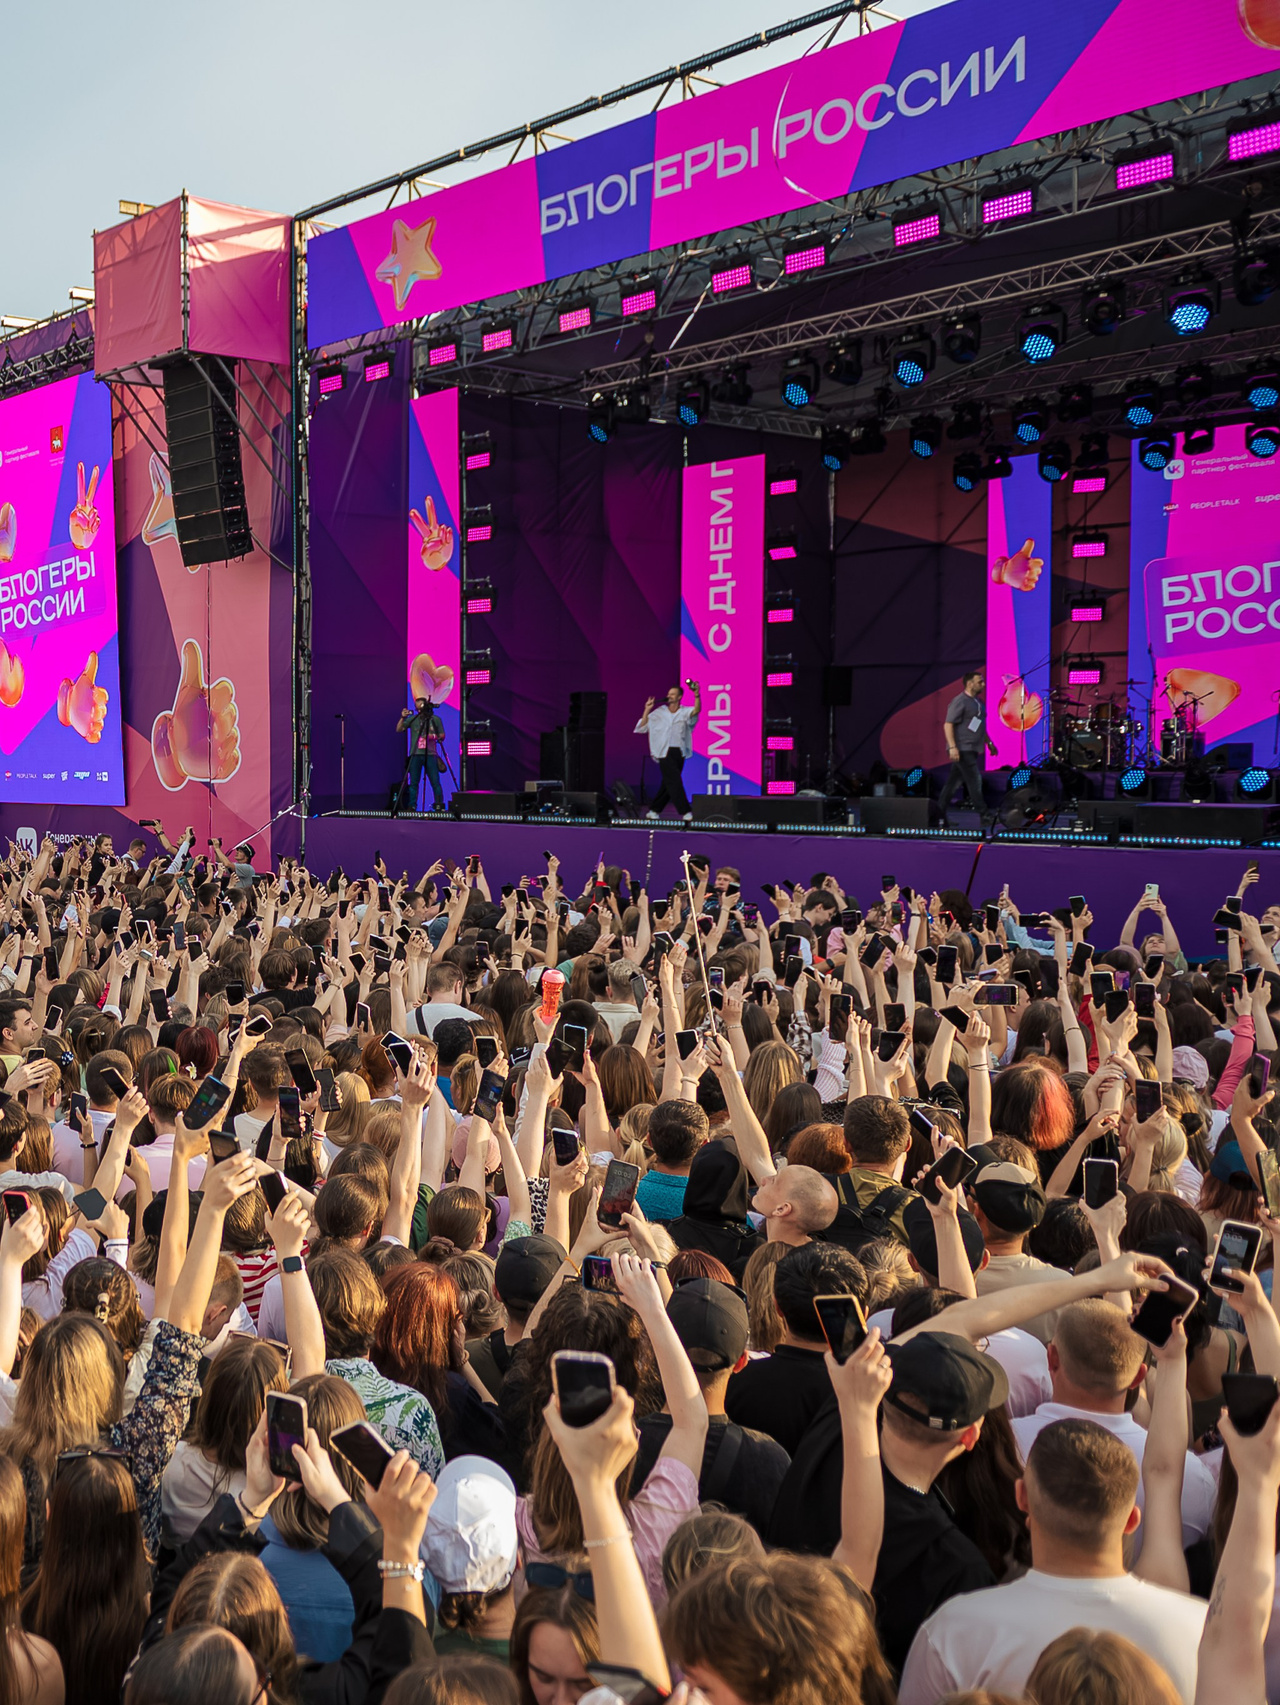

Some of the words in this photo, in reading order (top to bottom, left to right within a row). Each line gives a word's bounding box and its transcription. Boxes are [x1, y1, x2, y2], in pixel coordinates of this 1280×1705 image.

[540, 127, 758, 236] БЛОГЕРЫ
[777, 34, 1027, 160] РОССИИ
[1190, 453, 1248, 466] Генеральный
[1191, 465, 1227, 475] партнер
[1228, 459, 1276, 471] фестиваля
[708, 487, 736, 615] ДНЕМ
[0, 586, 86, 633] РОССИИ
[708, 622, 732, 652] С
